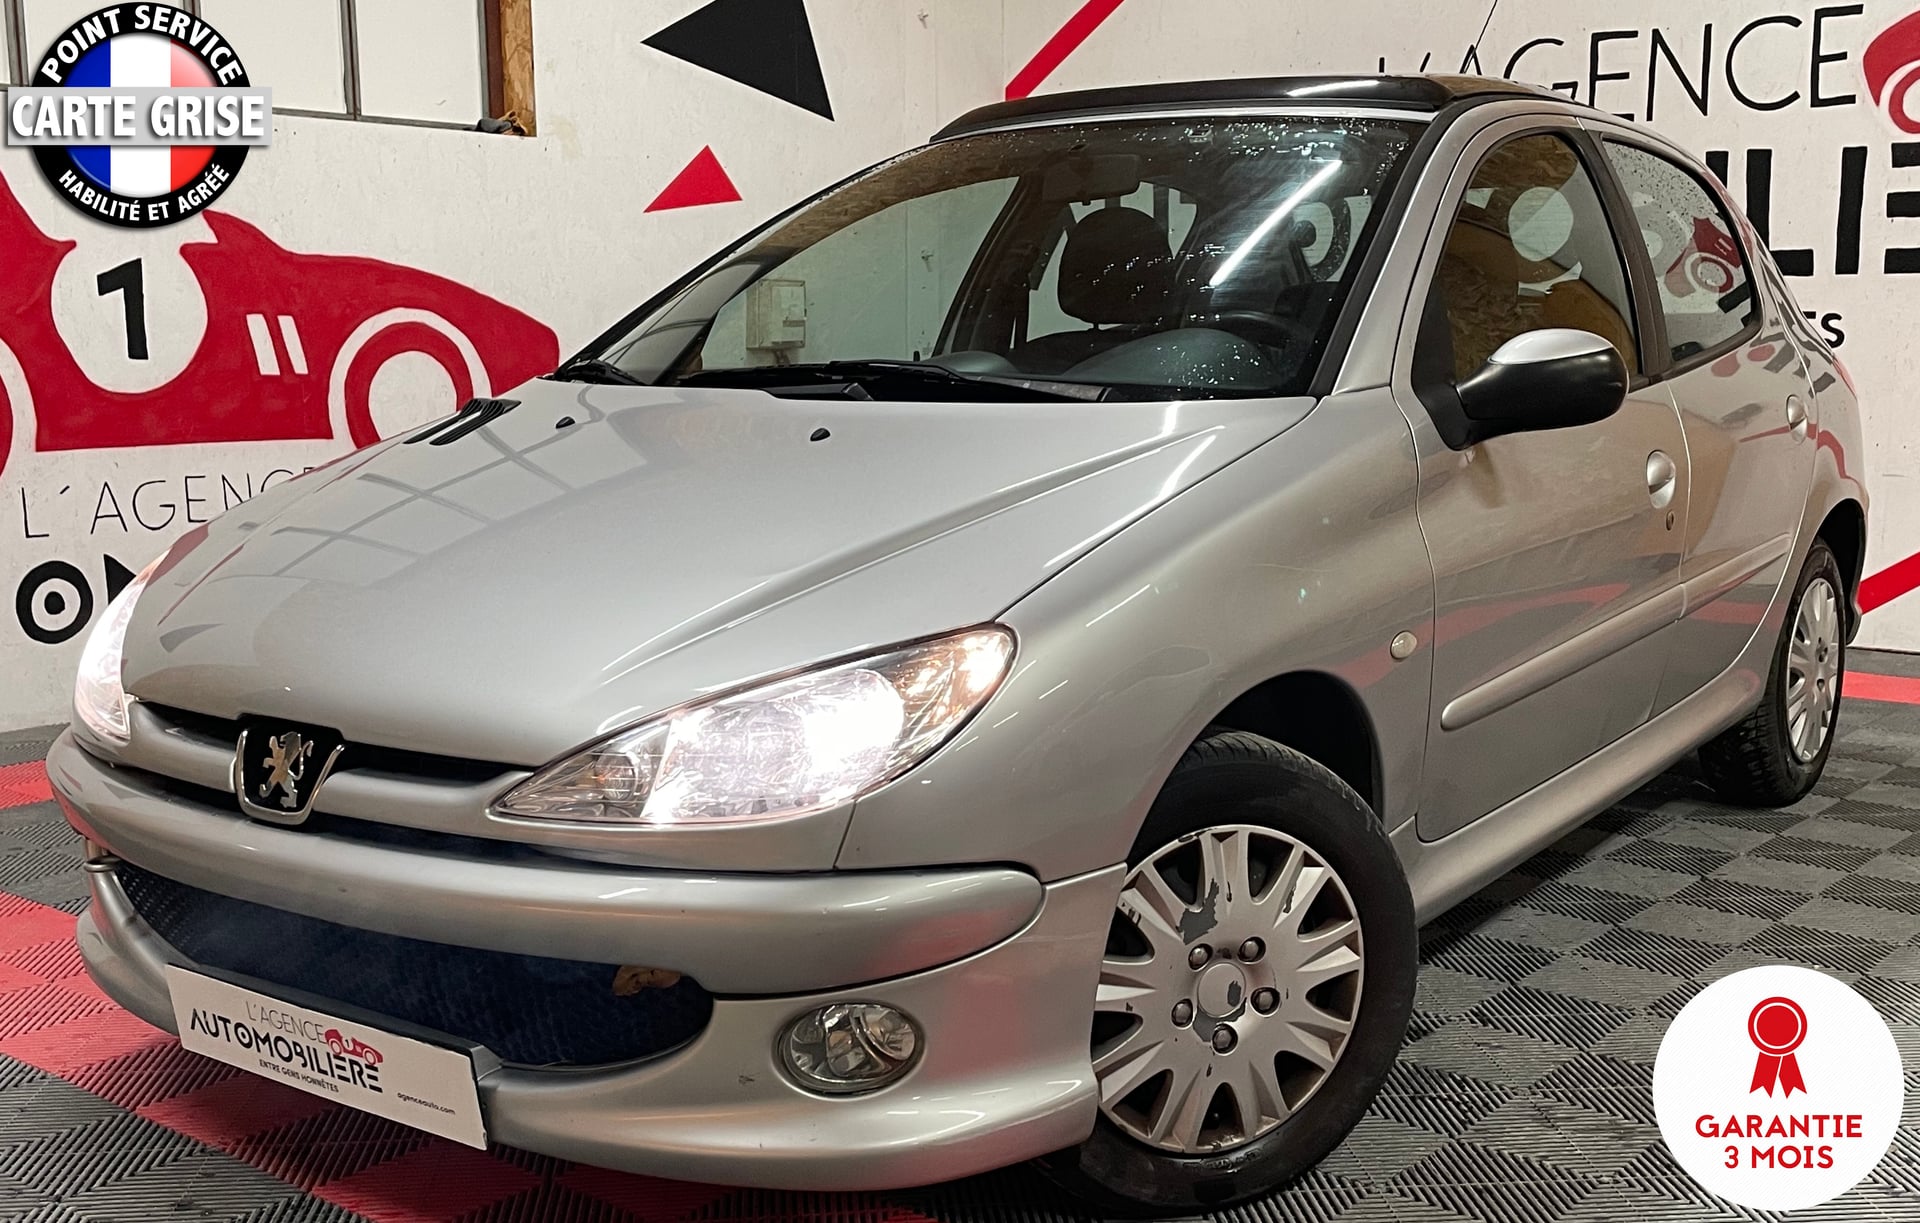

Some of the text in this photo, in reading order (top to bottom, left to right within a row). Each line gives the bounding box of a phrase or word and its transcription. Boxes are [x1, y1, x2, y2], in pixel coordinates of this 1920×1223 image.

[97, 257, 149, 360] 1
[245, 1001, 326, 1043] L'AGENCE
[259, 1059, 339, 1093] ENTRE GENS HONNÊTES
